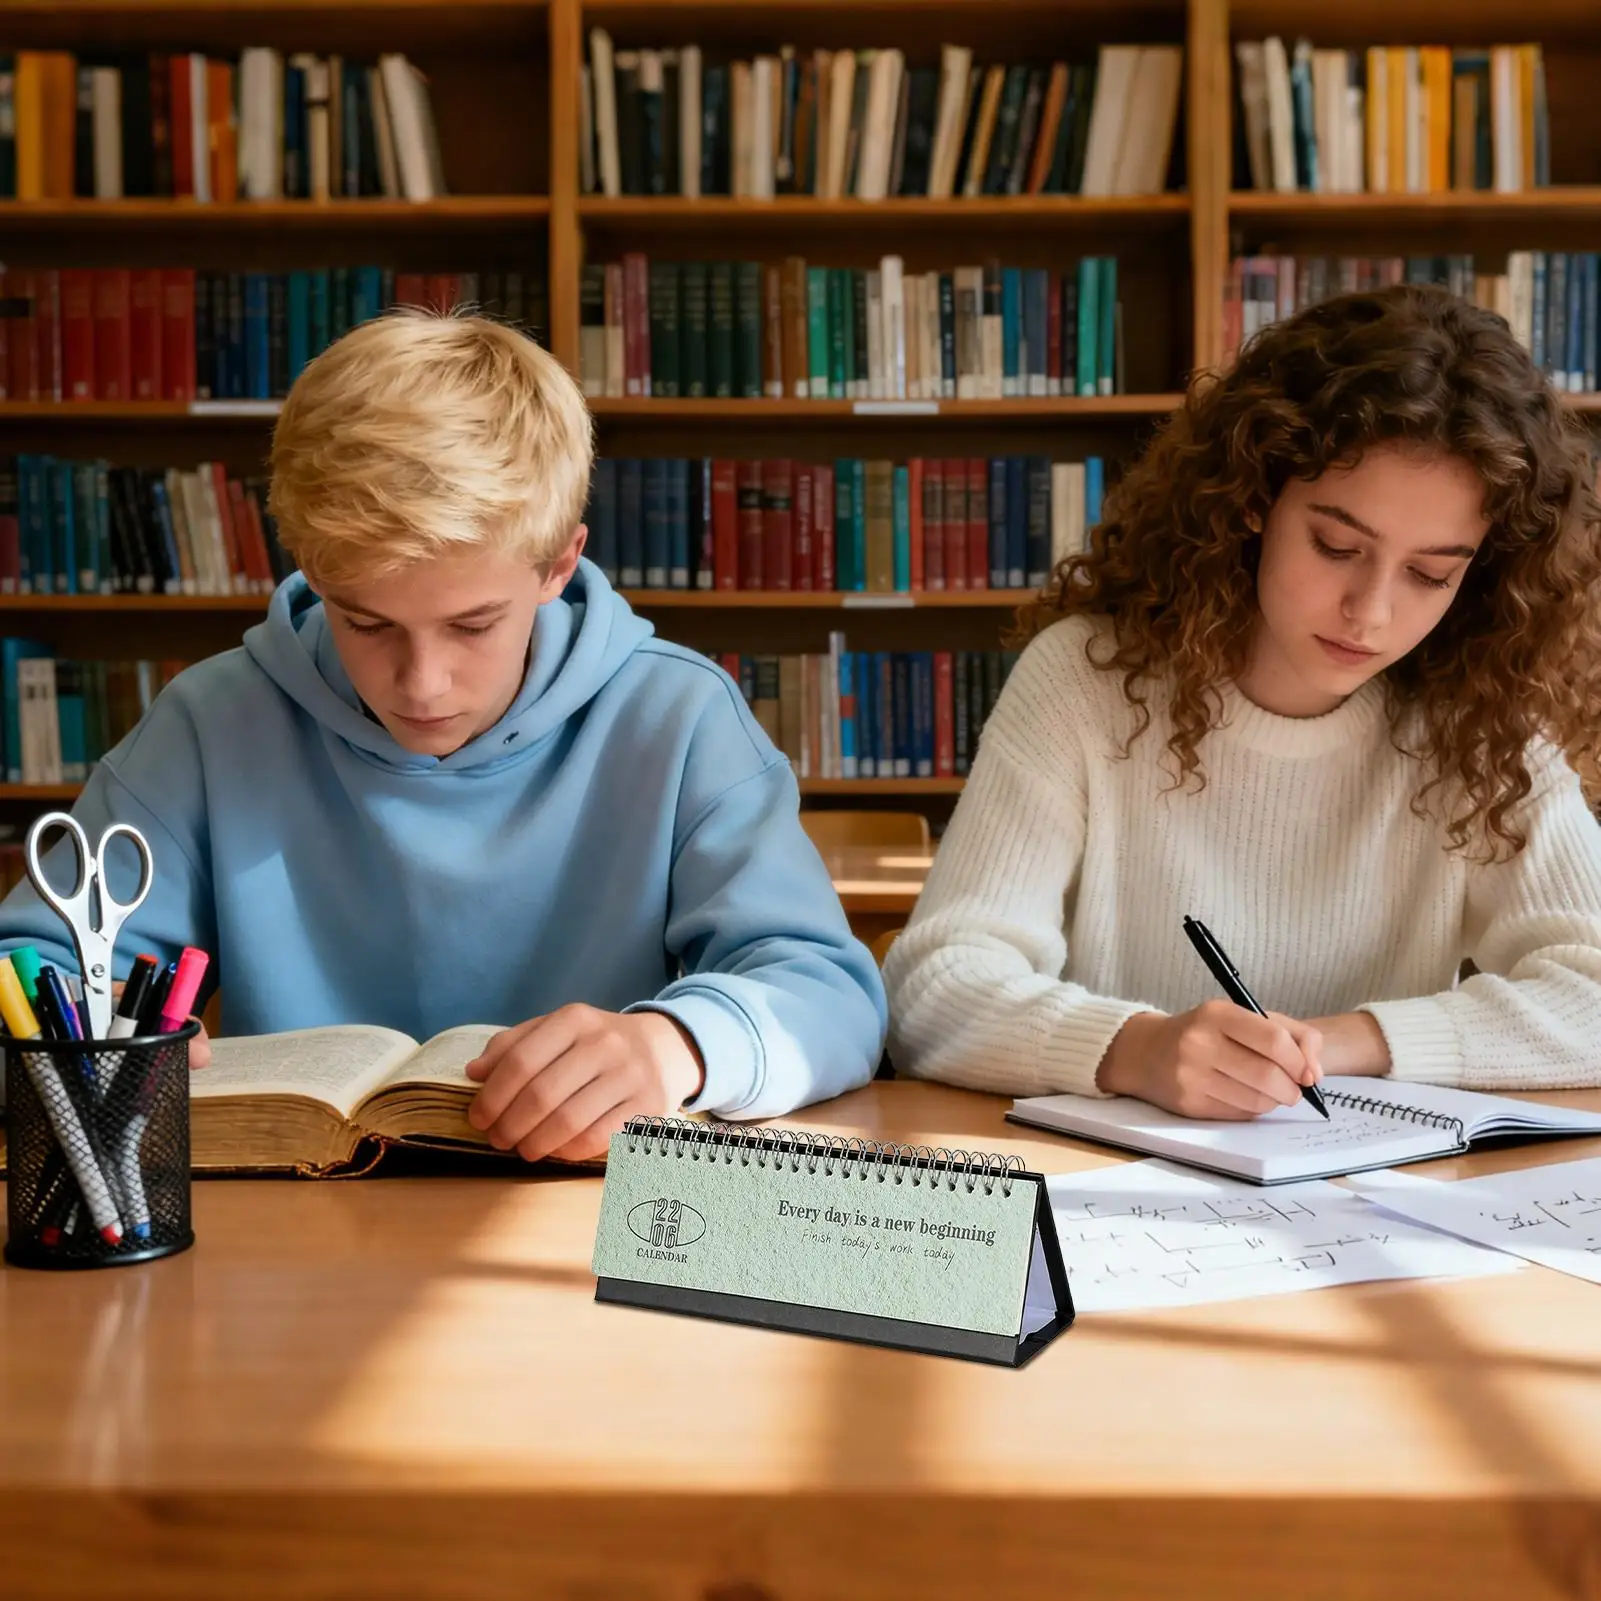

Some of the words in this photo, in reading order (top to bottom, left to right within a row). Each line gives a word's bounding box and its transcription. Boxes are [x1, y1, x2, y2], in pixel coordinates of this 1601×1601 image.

[655, 1198, 681, 1223] 22
[778, 1199, 821, 1224] Every
[824, 1206, 851, 1227] day
[853, 1209, 867, 1226] is
[871, 1216, 880, 1228] a
[883, 1217, 916, 1233] new
[919, 1217, 997, 1247] beginning
[651, 1223, 677, 1249] 06
[636, 1247, 688, 1263] CALENDAR
[801, 1228, 832, 1244] Finish
[841, 1235, 880, 1260] today's
[889, 1243, 914, 1255] work
[923, 1246, 956, 1271] today
